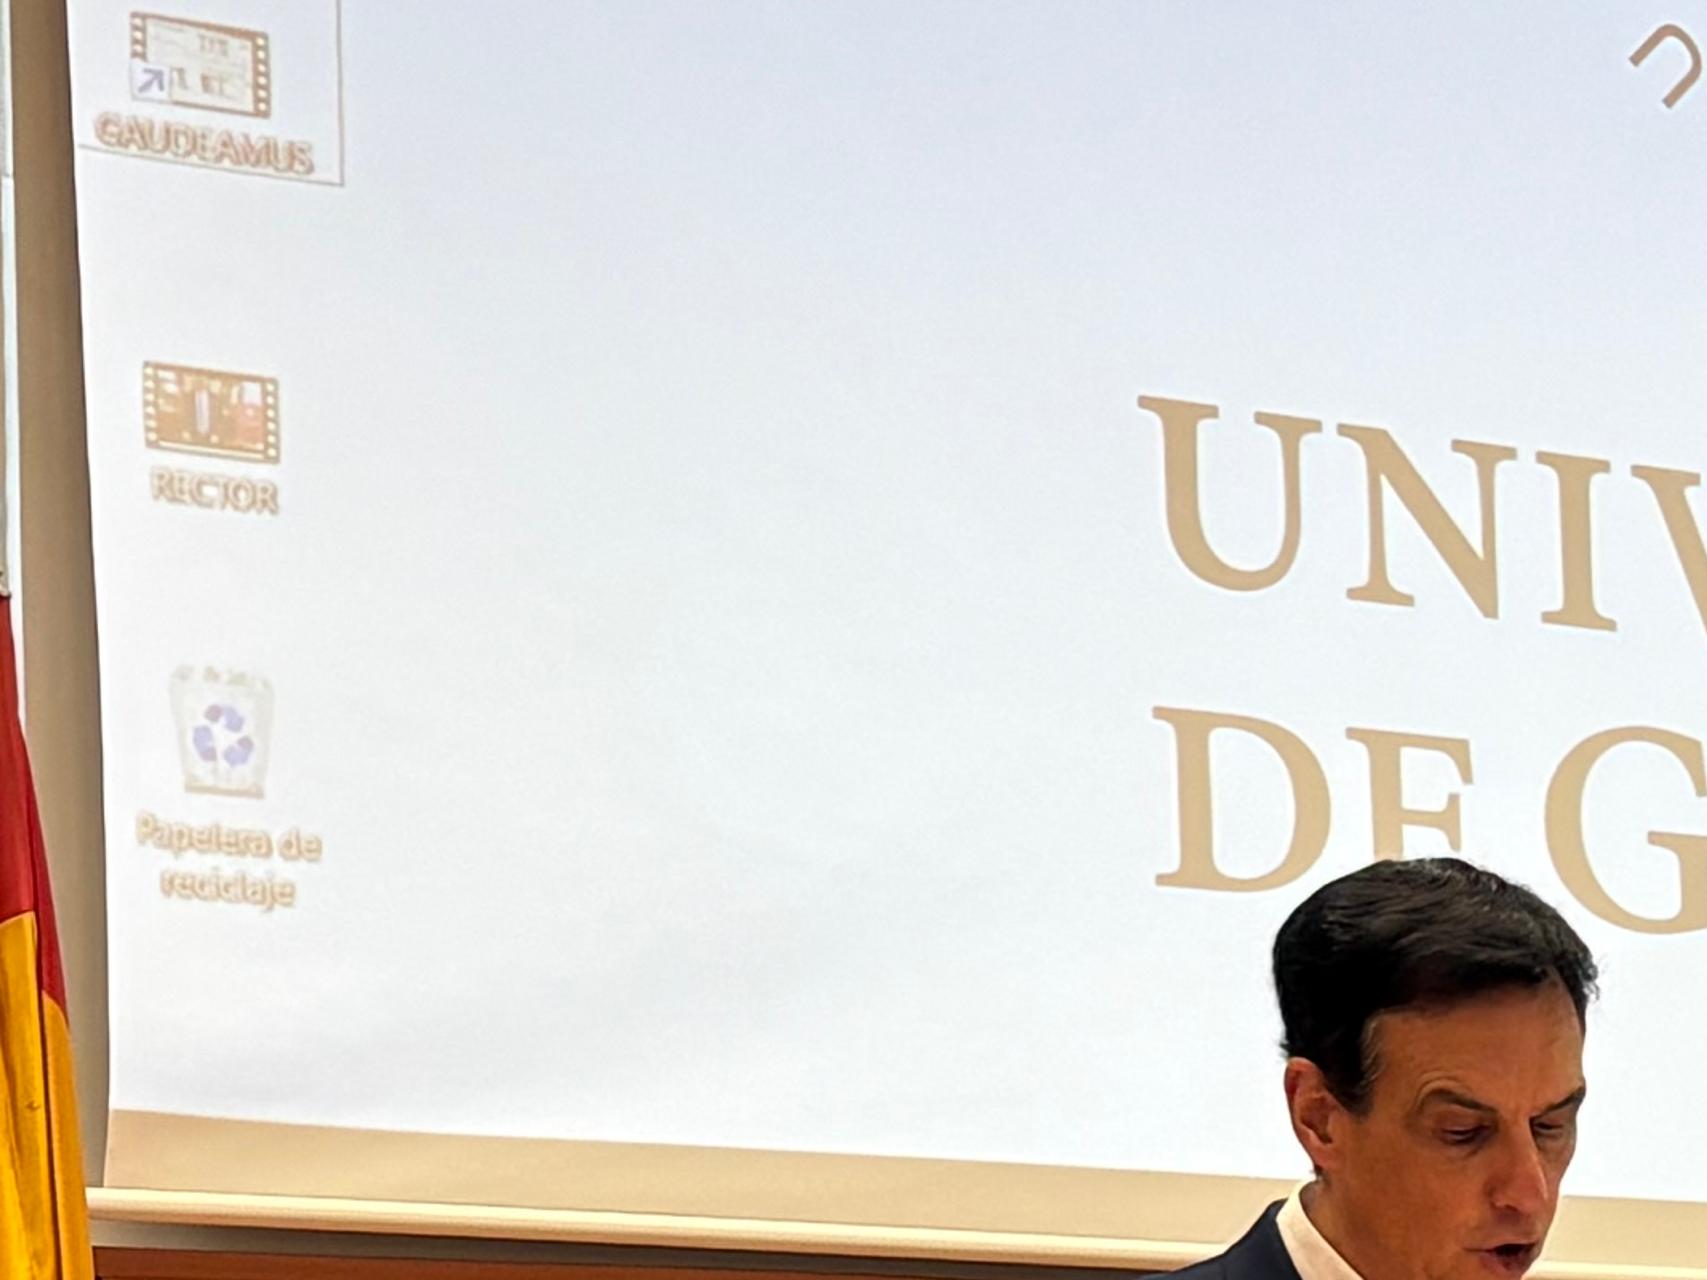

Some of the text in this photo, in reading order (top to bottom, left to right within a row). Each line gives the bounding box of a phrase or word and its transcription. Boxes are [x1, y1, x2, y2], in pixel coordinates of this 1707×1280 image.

[94, 111, 315, 175] GAUDEAMUS
[151, 466, 279, 515] RECTOR
[1152, 705, 1474, 892] DE
[136, 810, 323, 863] Papelera de
[160, 866, 296, 912] reciclaje
